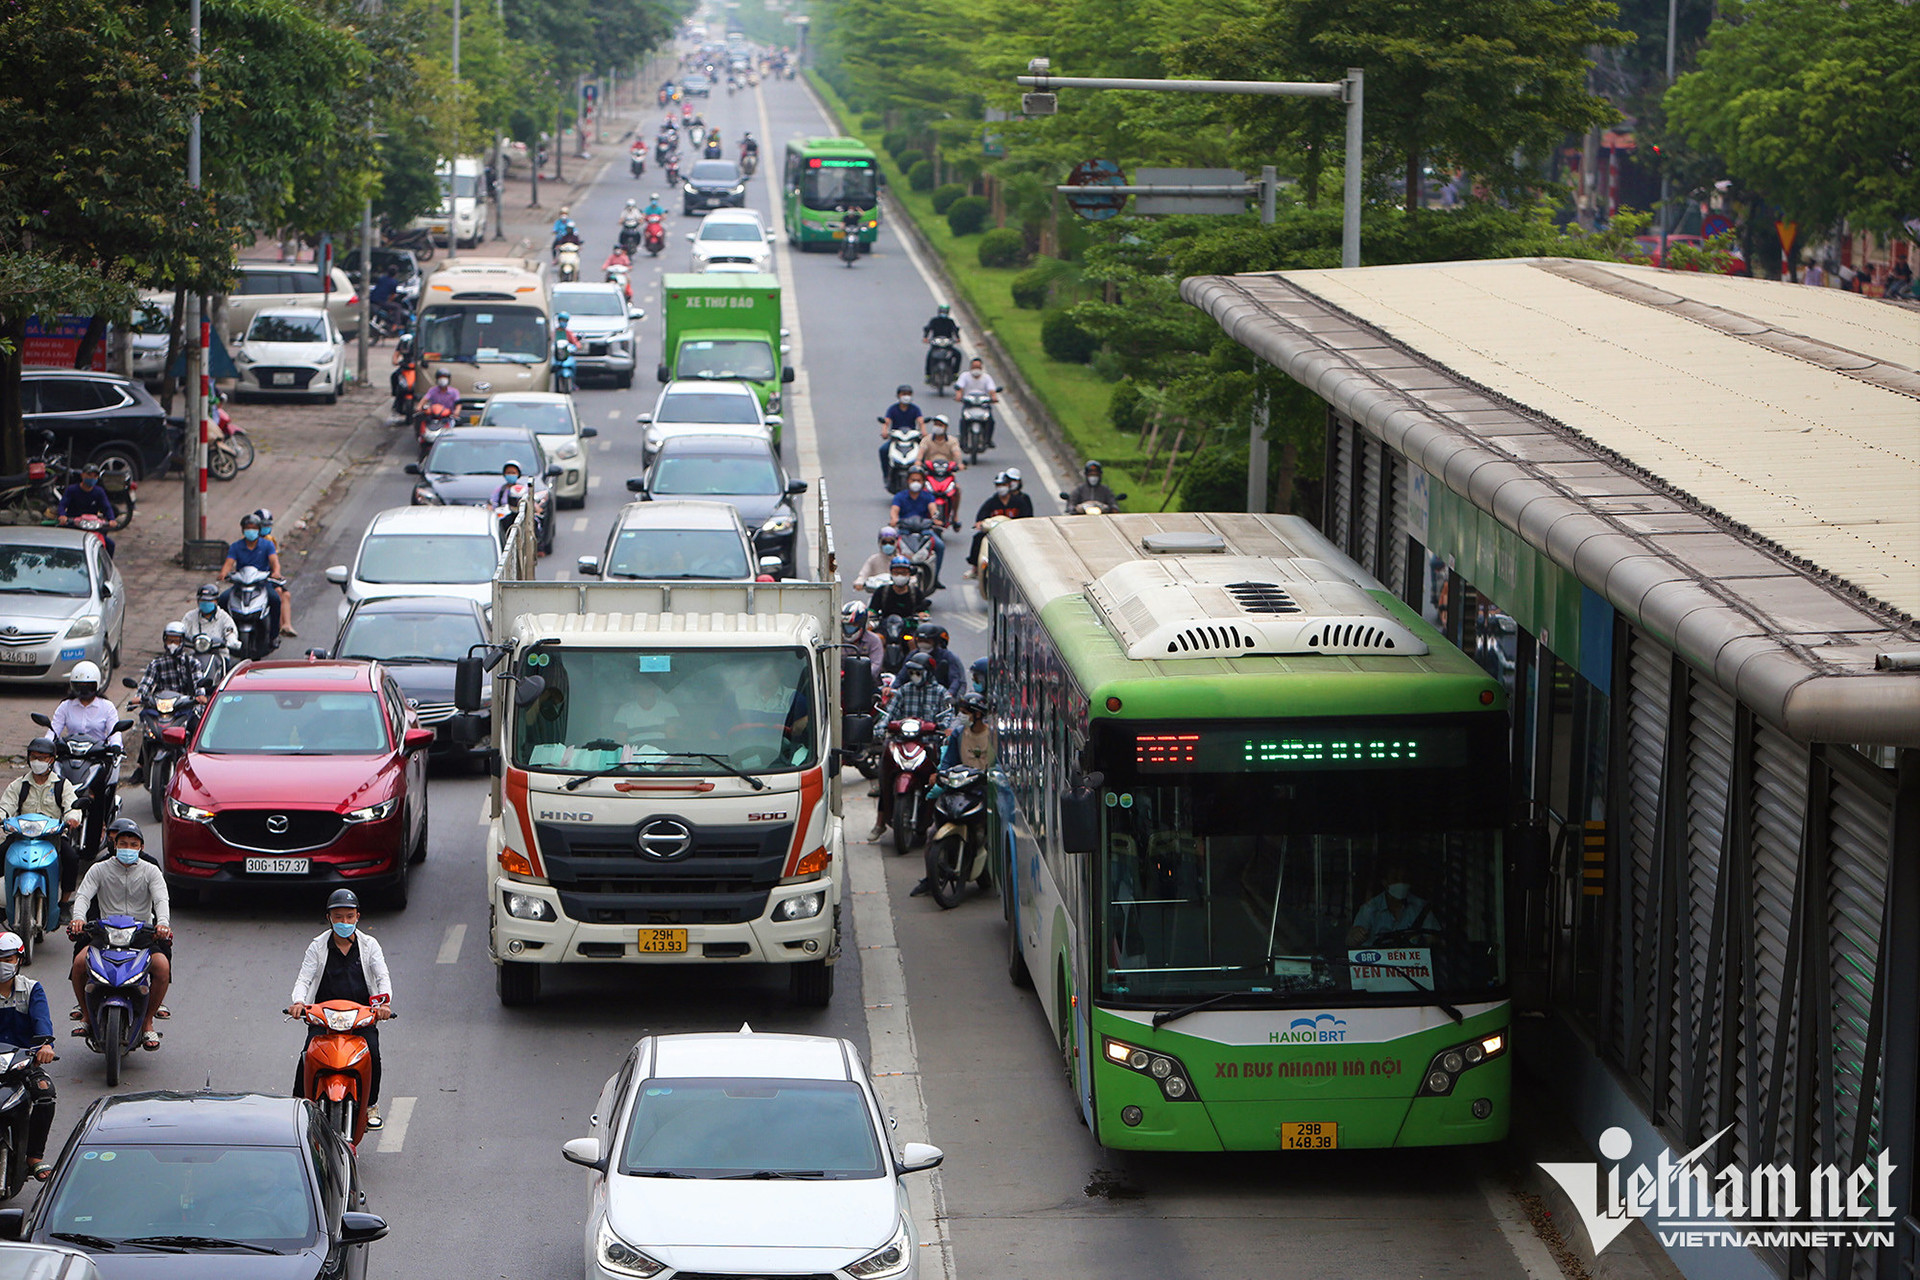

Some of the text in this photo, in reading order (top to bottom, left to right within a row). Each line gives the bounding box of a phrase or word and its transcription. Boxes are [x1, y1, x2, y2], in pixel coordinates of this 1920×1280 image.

[686, 293, 754, 308] XE THƯ BÁO
[540, 810, 594, 822] HINO
[747, 811, 788, 821] 500
[247, 859, 307, 872] 30G-157.37
[652, 929, 674, 940] 29H
[643, 941, 682, 951] 413.93
[1360, 952, 1376, 962] BRT
[1409, 951, 1421, 960] XE
[1243, 1062, 1273, 1078] BUS
[1278, 1060, 1337, 1078] NHANH
[1343, 1057, 1365, 1077] HÀ
[1370, 1056, 1401, 1079] NỘI
[1297, 1123, 1321, 1136] 29B
[1288, 1136, 1332, 1149] 148.38
